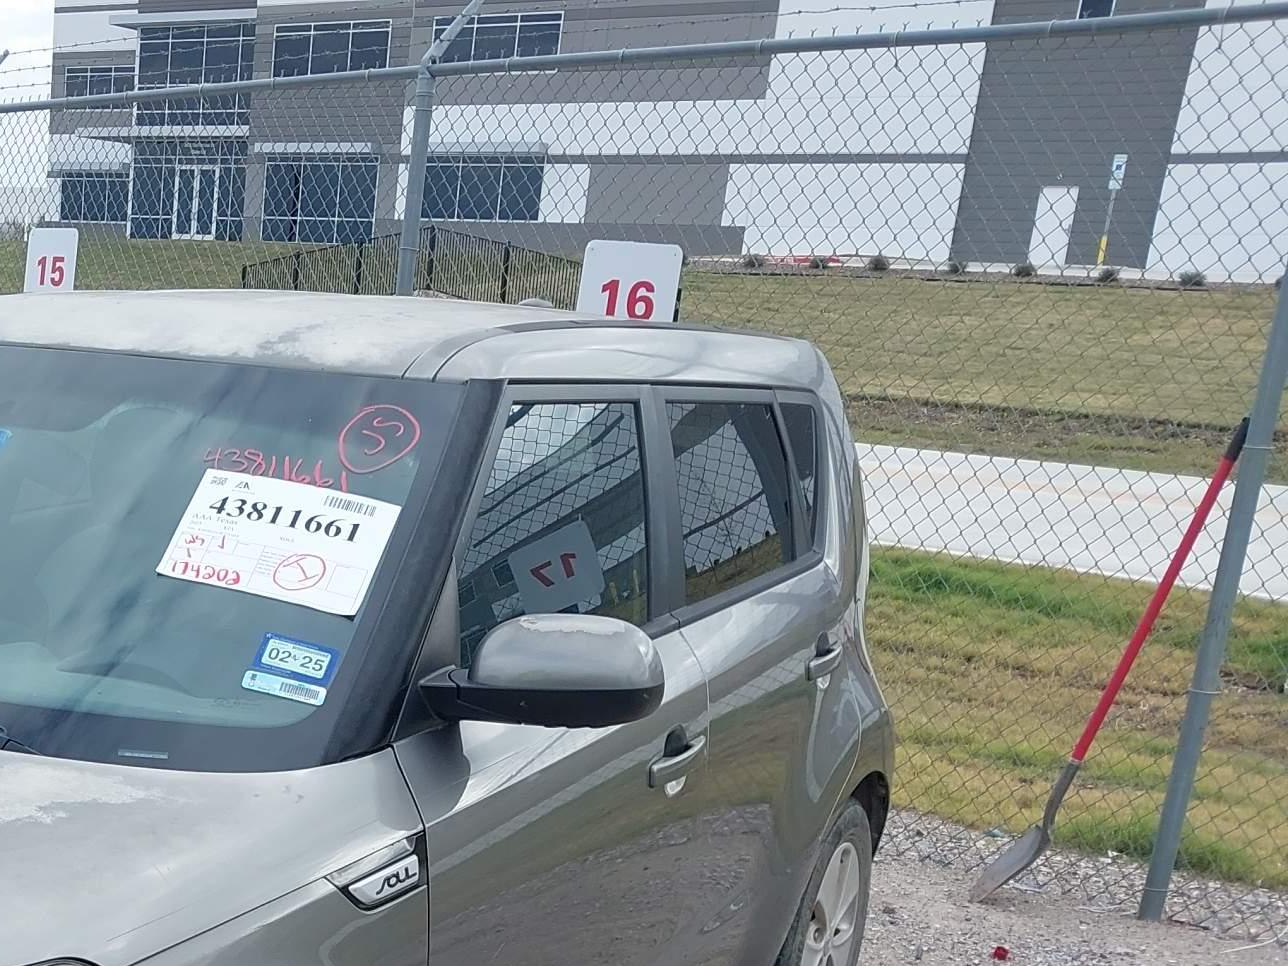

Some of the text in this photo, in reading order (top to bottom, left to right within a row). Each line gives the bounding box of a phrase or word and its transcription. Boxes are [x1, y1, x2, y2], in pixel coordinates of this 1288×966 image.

[37, 255, 65, 287] 15
[601, 279, 655, 320] 16
[203, 447, 348, 493] 43811661
[209, 496, 361, 543] 43811661
[171, 560, 241, 586] 174202
[268, 647, 292, 664] 02
[299, 655, 326, 673] 25
[376, 866, 418, 896] SOUL
